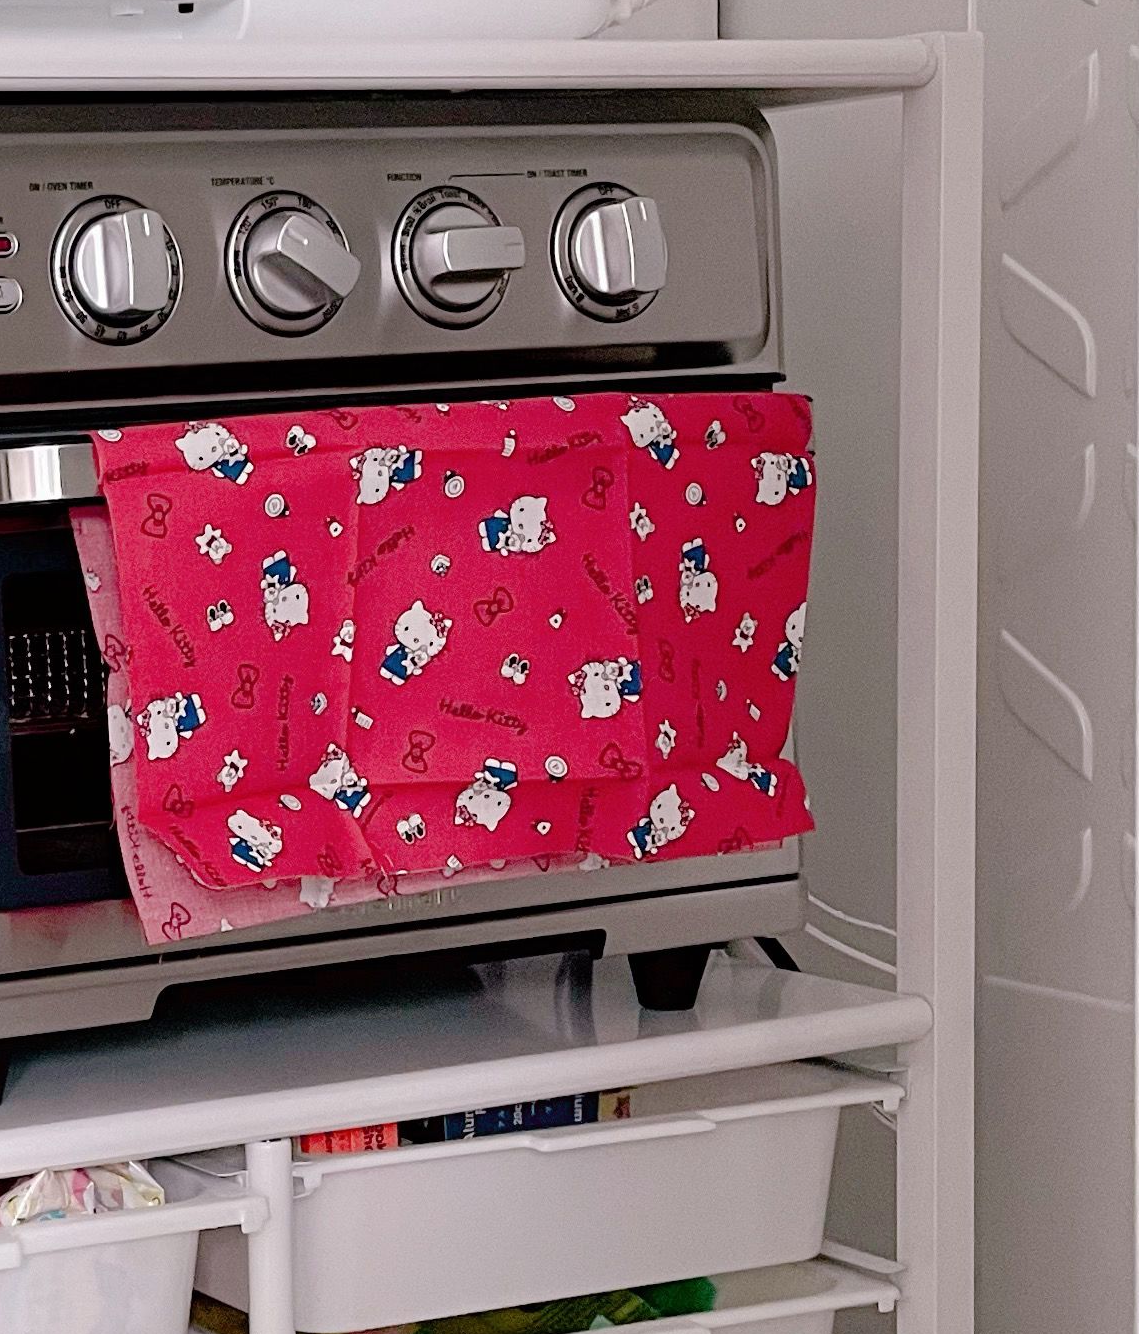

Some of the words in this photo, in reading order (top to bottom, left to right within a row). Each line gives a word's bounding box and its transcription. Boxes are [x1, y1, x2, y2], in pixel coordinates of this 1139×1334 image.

[47, 182, 68, 191] OVEN
[69, 181, 94, 190] TIMER
[387, 173, 422, 182] FUNCTION
[143, 586, 174, 628] Hello
[169, 624, 197, 668] Kitty
[276, 674, 294, 722] Kitty
[438, 697, 486, 720] Hello
[485, 708, 529, 745] Kitty
[275, 723, 290, 771] Hello
